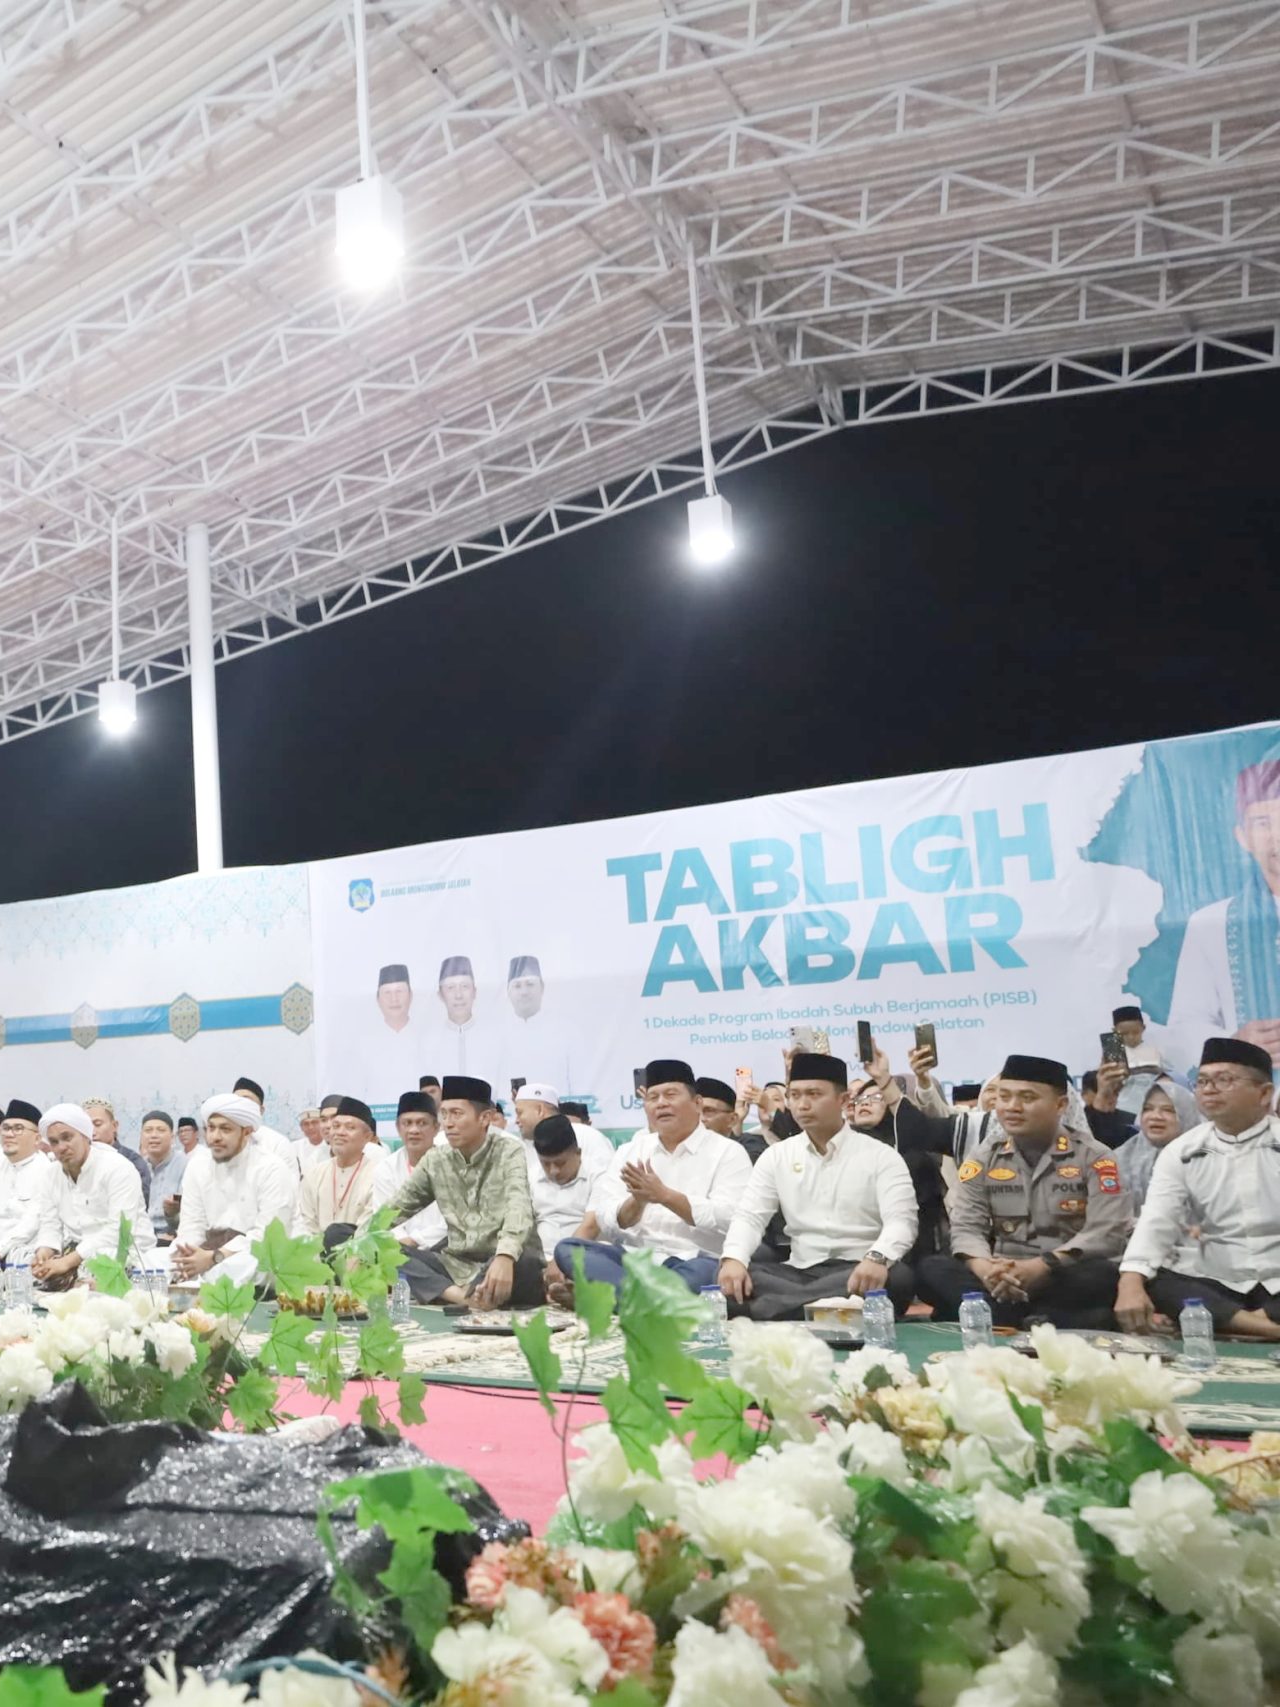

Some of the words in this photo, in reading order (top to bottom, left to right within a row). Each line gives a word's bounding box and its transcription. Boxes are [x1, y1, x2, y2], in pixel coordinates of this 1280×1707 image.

[606, 802, 1056, 924] TABLIGH
[641, 892, 1029, 998] AKBAR
[644, 1018, 650, 1029] 1
[653, 1014, 705, 1029] Dekade
[708, 1012, 773, 1027] Program
[777, 1005, 830, 1020] Ibadah
[834, 1000, 883, 1017] Subuh
[887, 995, 978, 1014] Berjamaah
[983, 989, 1038, 1007] (PISB)
[690, 1031, 748, 1045] Pemkab
